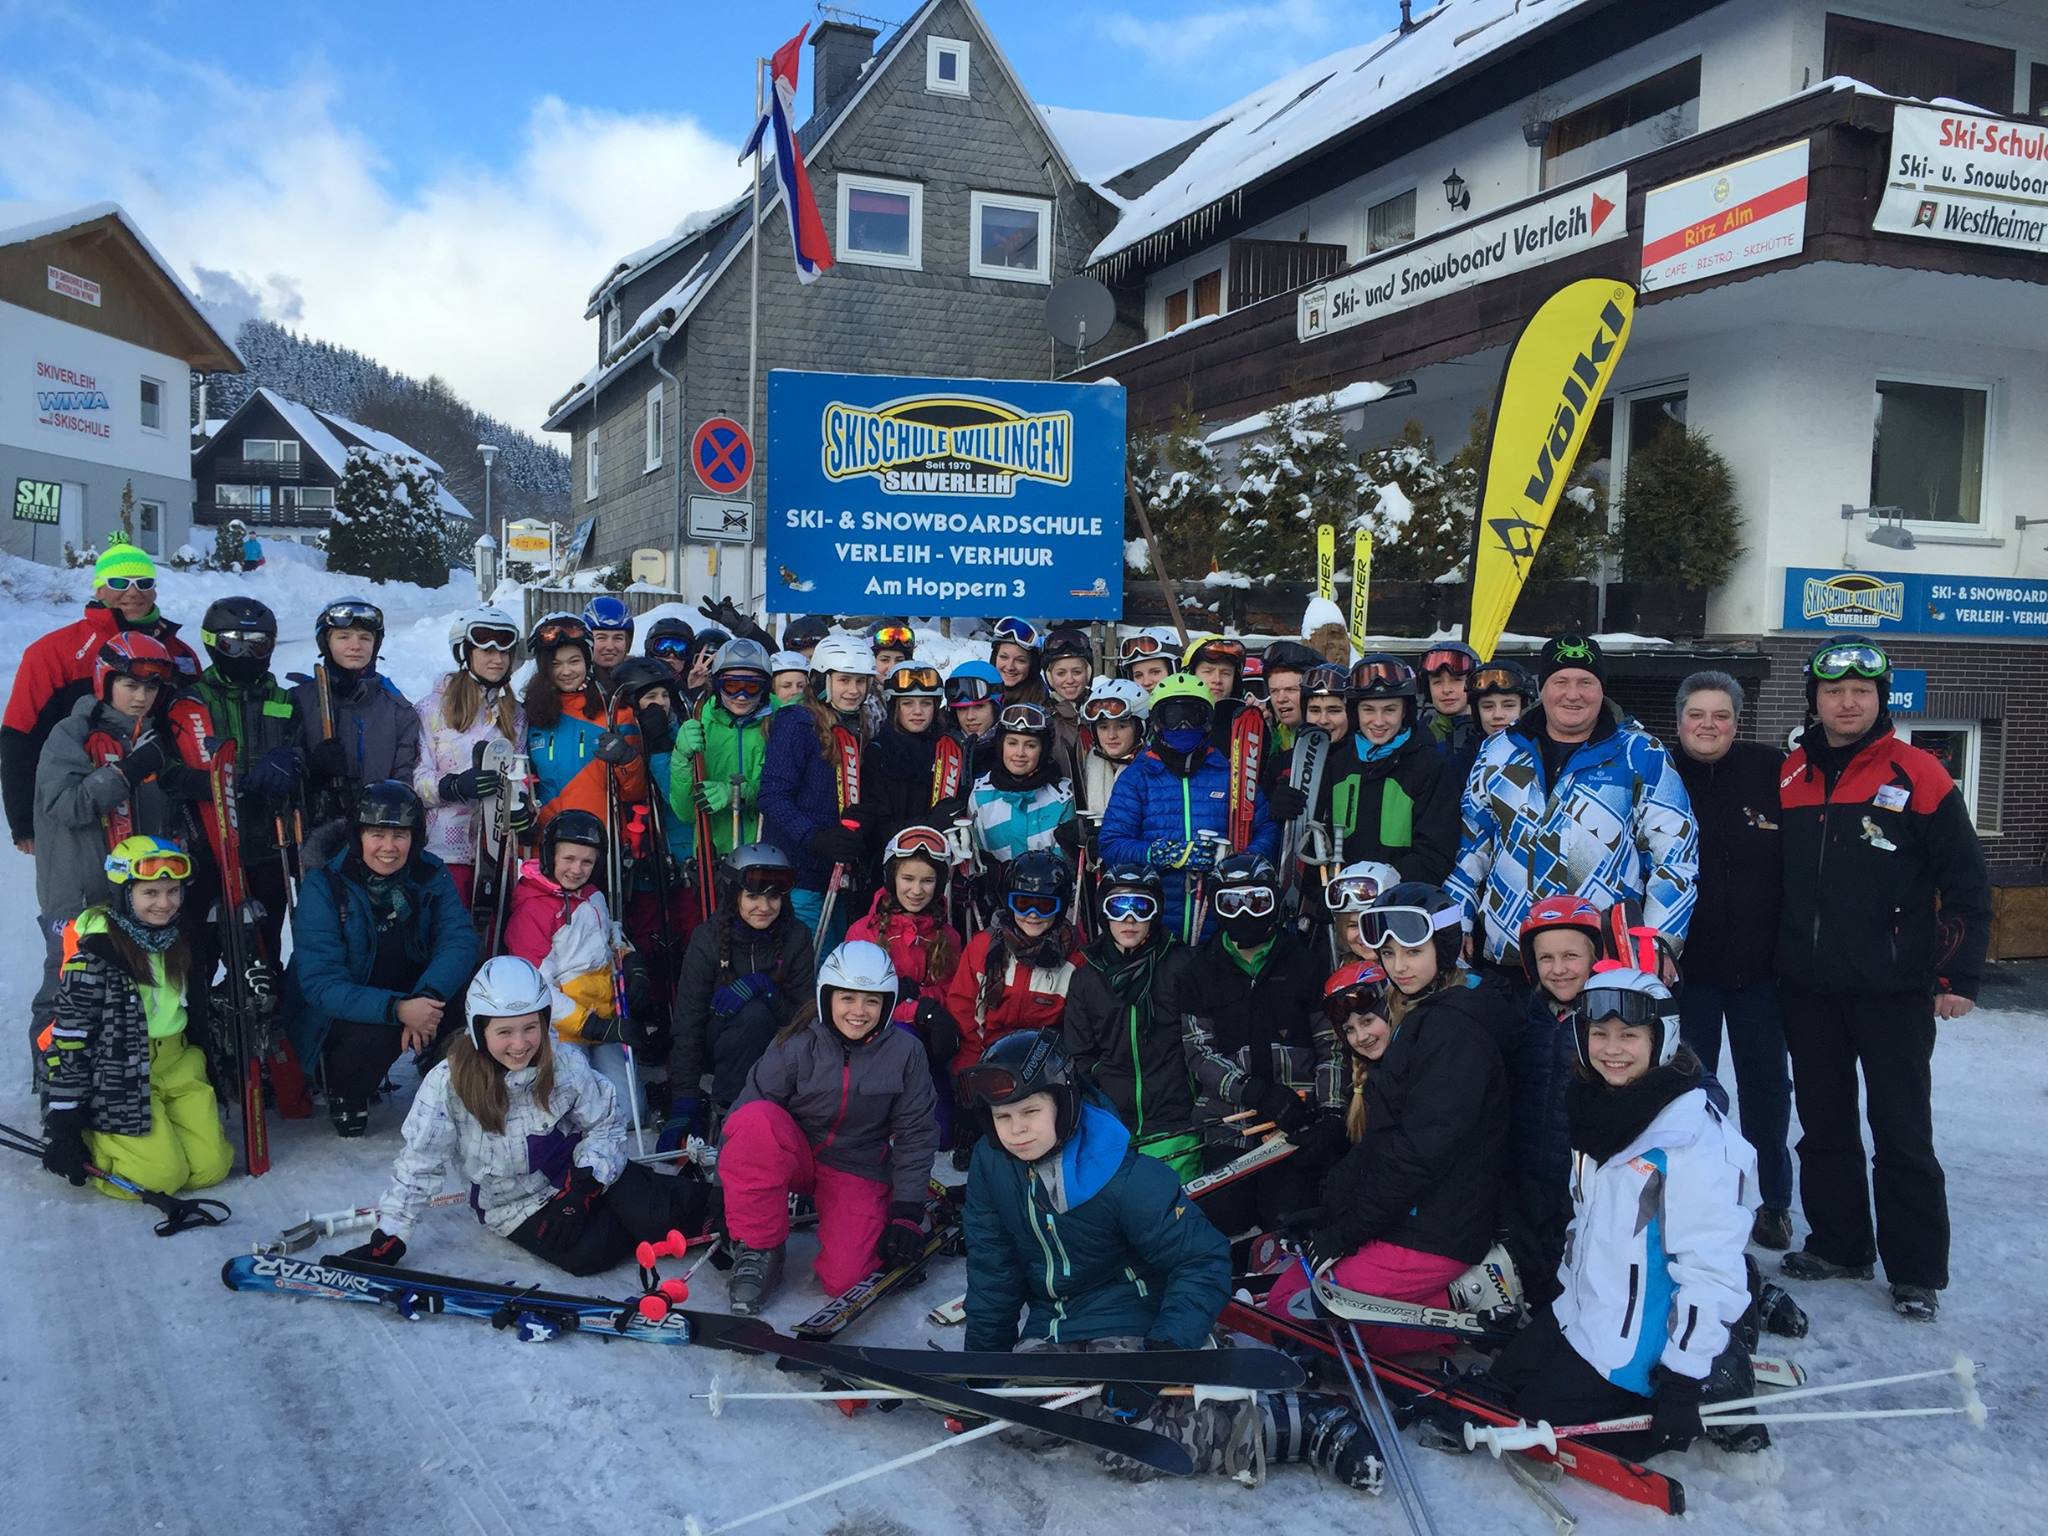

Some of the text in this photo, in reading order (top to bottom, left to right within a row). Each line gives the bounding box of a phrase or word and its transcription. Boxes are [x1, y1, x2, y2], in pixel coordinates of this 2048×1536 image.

[1898, 153, 1935, 178] Ski-
[1942, 168, 1956, 183] u.
[1684, 207, 1754, 248] Ritz Alm
[1943, 204, 2048, 242] Westheimer
[1331, 206, 1588, 319] Ski- und Snowboard Verleih
[1696, 250, 1733, 270] BISTRO
[37, 361, 96, 390] SKIVERLEIH
[37, 391, 110, 411] WIWA
[54, 412, 110, 438] SKISCHULE
[830, 410, 1066, 477] SKISCHULE WILLINGEN
[925, 460, 971, 471] Seit 1970
[17, 480, 61, 509] SKI
[885, 472, 1011, 494] SKIVERLEIH
[786, 509, 1103, 535] SKI- & SNOWBOARDSCHULE
[835, 543, 931, 564] VERLEIH
[951, 546, 1054, 567] VERHUUR
[864, 576, 1026, 601] Am Hoppern 3
[1353, 558, 1367, 640] FISCHER
[1807, 583, 1901, 615] SKISCHULE WILLINGEN
[1931, 585, 1957, 599] SKI-
[1958, 586, 1968, 600] &
[1828, 613, 1878, 625] SKIVERLEIH
[1955, 608, 2004, 623] VERLEIH
[1300, 733, 1322, 796] TOMIC
[252, 1255, 372, 1293] DYNASTAR
[805, 1272, 886, 1328] HEAD
